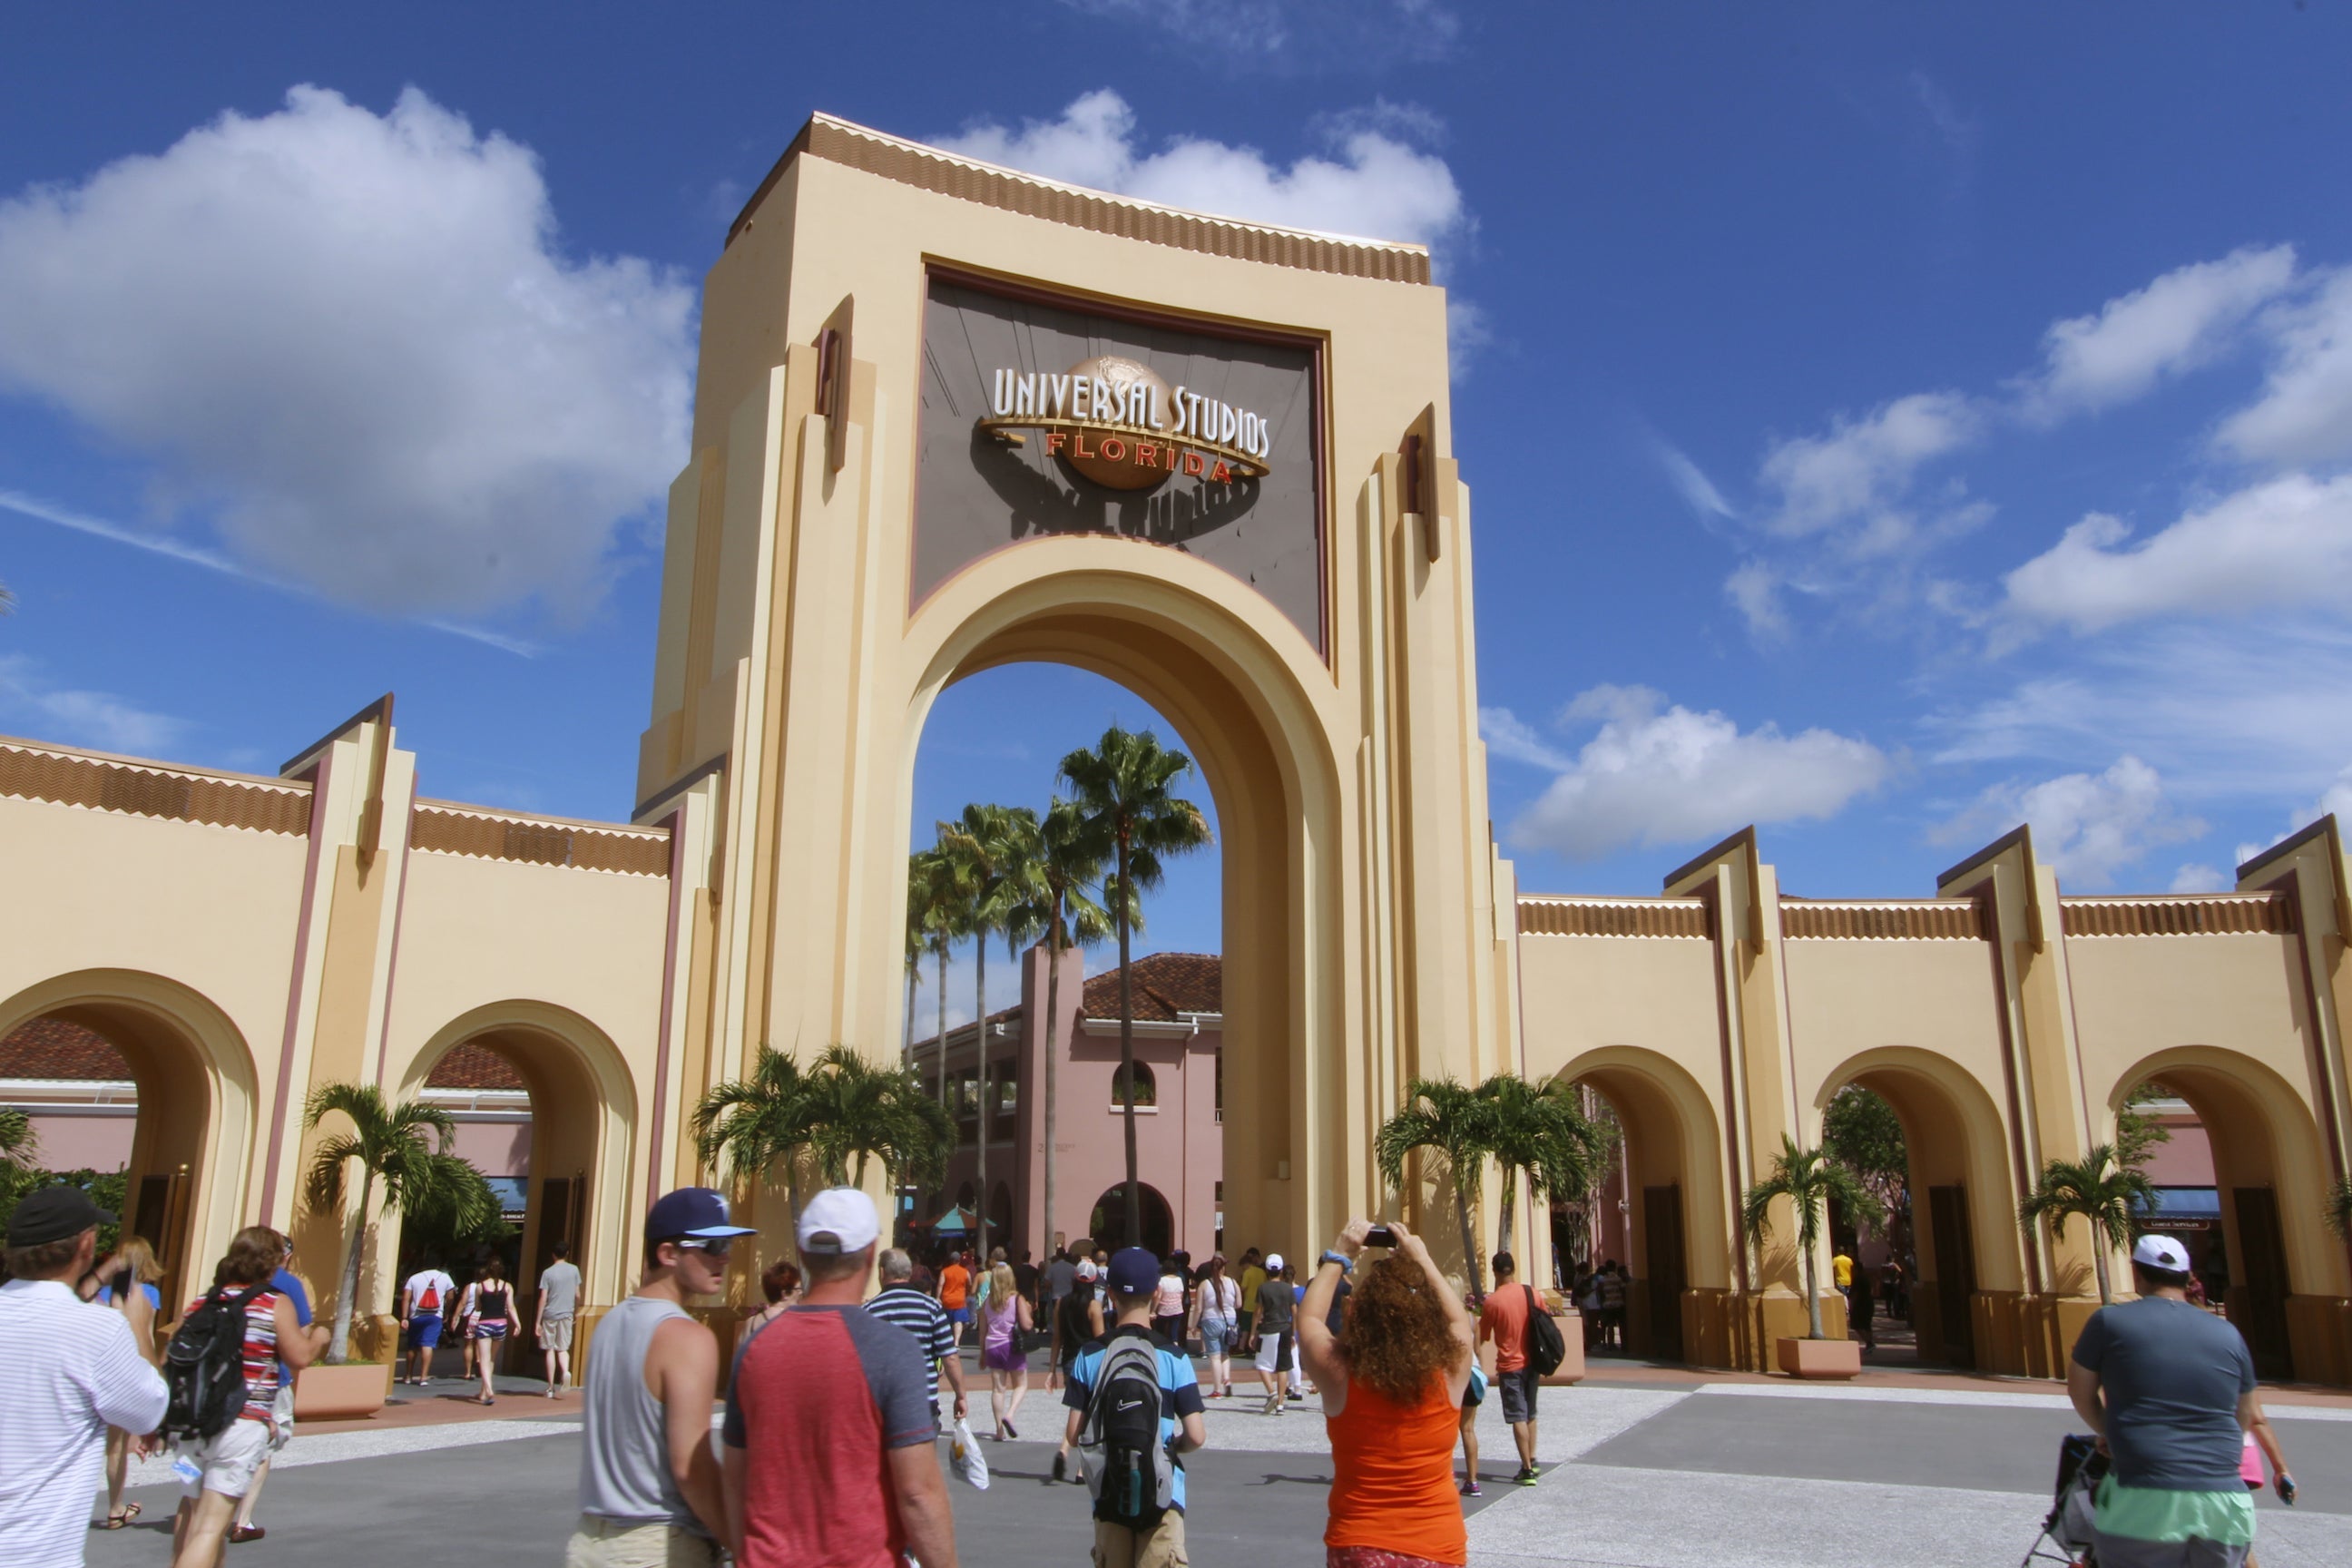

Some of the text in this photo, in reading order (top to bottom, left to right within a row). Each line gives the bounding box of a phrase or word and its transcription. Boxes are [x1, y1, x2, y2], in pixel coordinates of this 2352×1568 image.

[994, 368, 1269, 458] UNIVERSAL STUDIOS
[1045, 433, 1232, 485] FLORIDA
